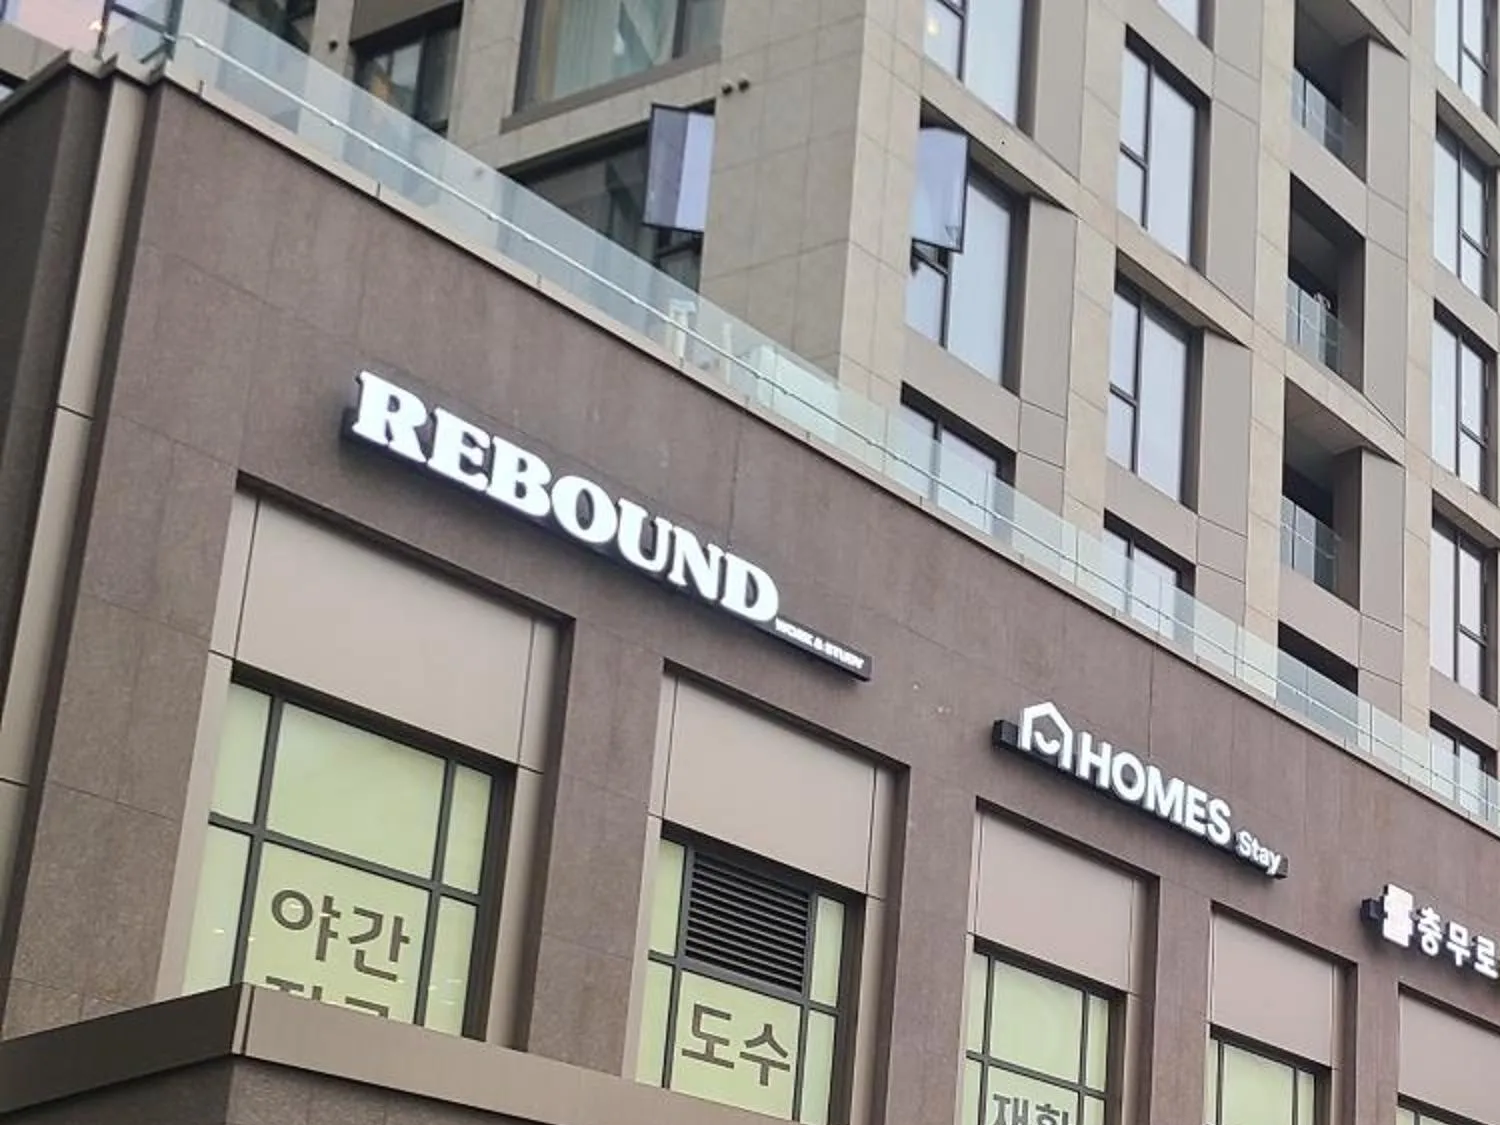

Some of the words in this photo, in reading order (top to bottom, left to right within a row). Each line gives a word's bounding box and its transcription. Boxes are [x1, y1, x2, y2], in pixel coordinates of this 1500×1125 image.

[352, 370, 779, 622] REBOUND
[1076, 731, 1231, 846] HOMES
[1235, 830, 1281, 876] Stay
[271, 888, 410, 981] 야간
[681, 1002, 792, 1086] 도수
